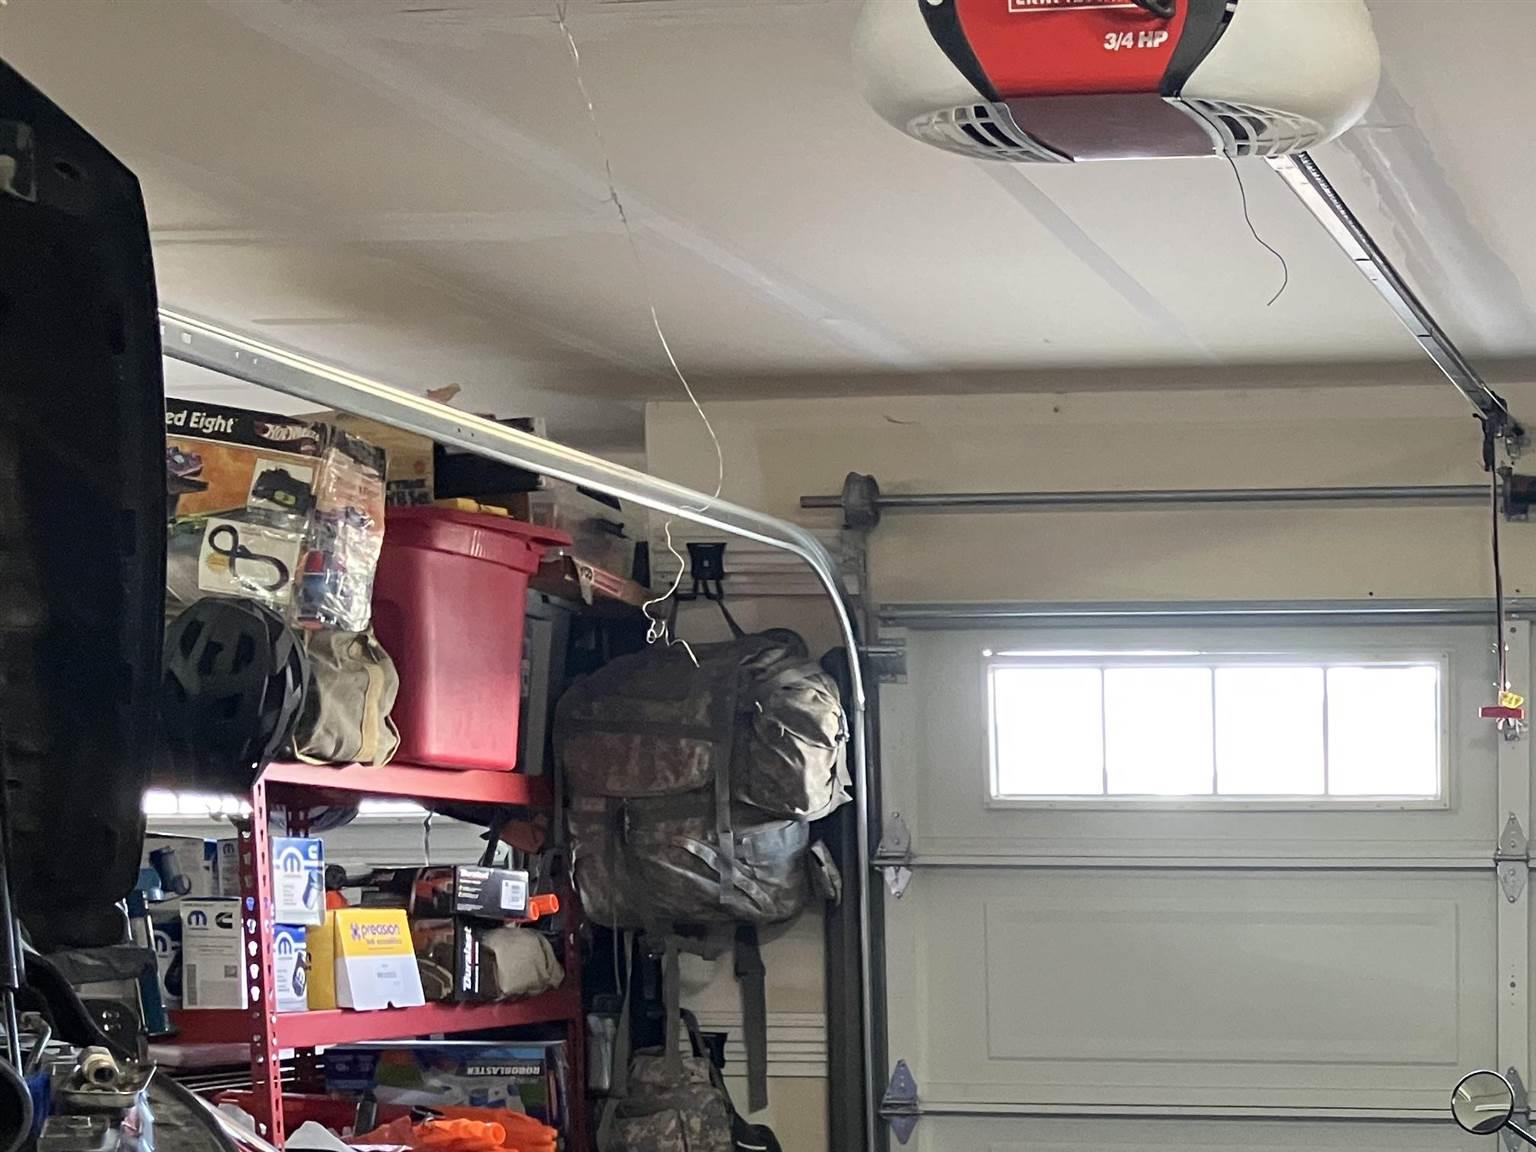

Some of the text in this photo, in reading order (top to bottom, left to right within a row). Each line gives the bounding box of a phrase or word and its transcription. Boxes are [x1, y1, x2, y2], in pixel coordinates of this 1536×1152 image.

[1103, 31, 1169, 51] 3/4 HP
[165, 410, 235, 433] ed Eight
[361, 923, 401, 939] precision
